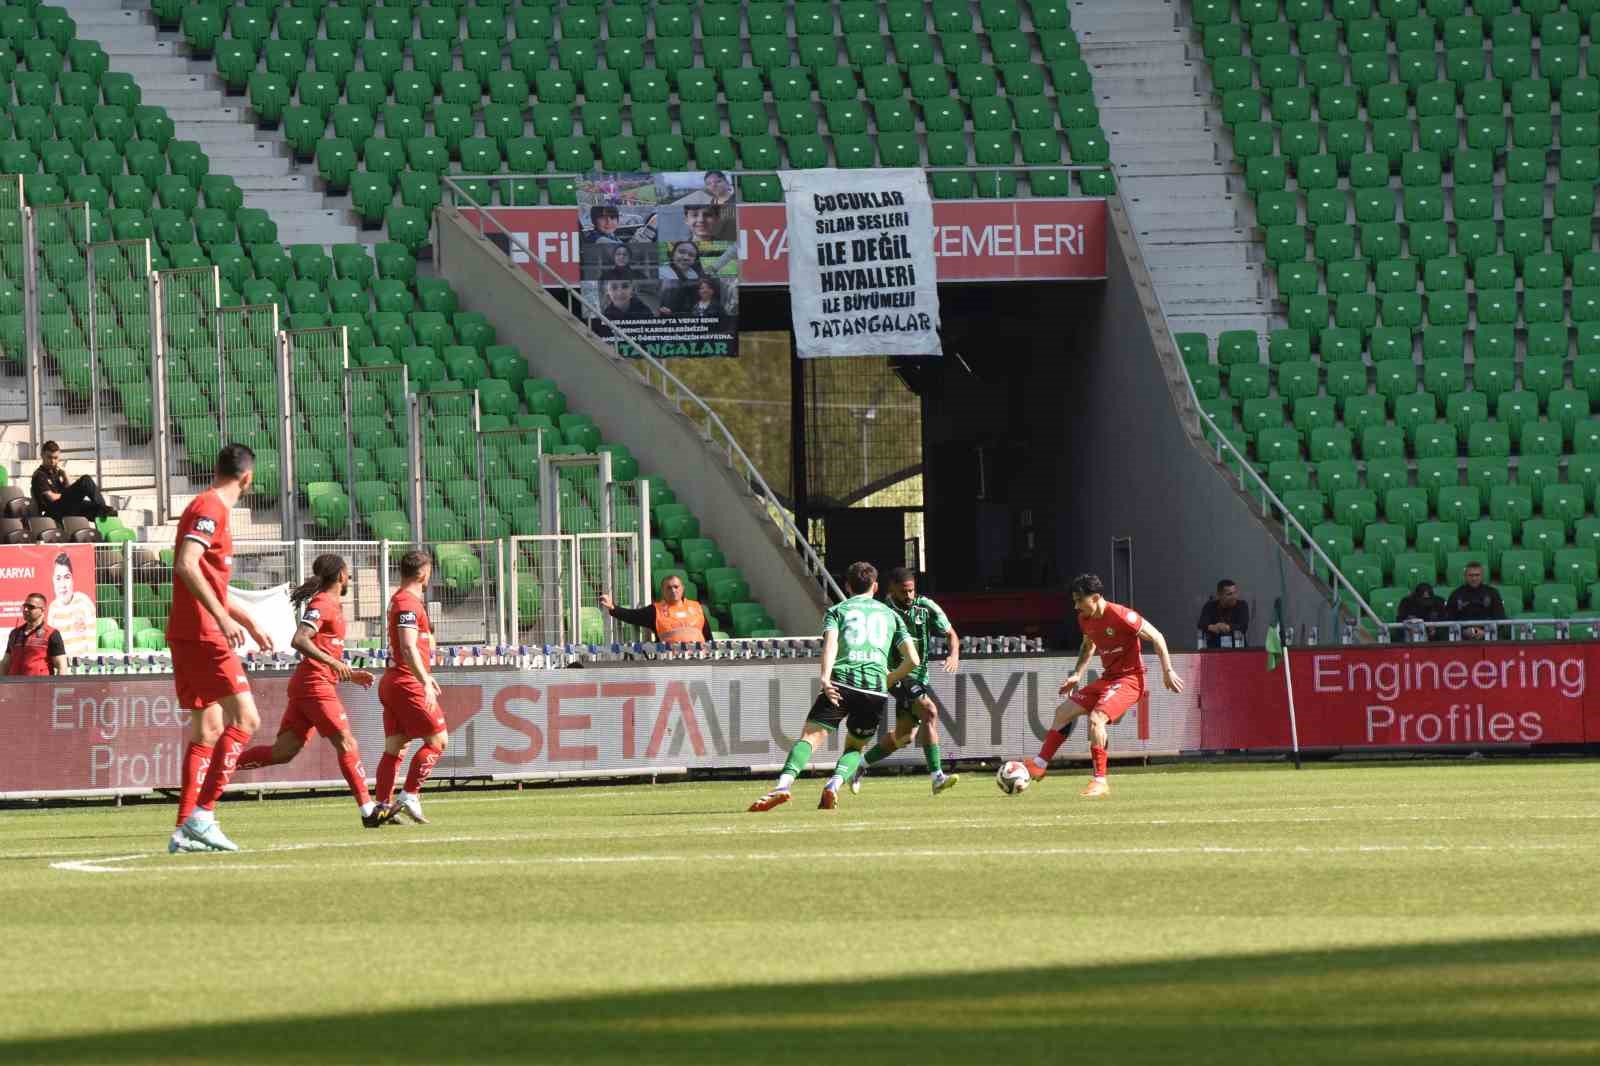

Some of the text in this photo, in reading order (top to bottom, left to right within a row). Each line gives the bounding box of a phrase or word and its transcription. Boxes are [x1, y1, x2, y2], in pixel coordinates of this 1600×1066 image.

[814, 191, 904, 214] ÇOCUKLAR
[816, 212, 909, 234] SİLAH SESLERİ
[817, 232, 911, 266] İLE DEĞİL
[820, 265, 916, 293] HAYALLERİ
[822, 298, 840, 314] İLE
[810, 313, 931, 338] TATANGALAR
[844, 609, 888, 648] 30
[1312, 652, 1586, 701] Engineering
[1364, 703, 1544, 743] Profiles
[90, 743, 182, 786] Profil
